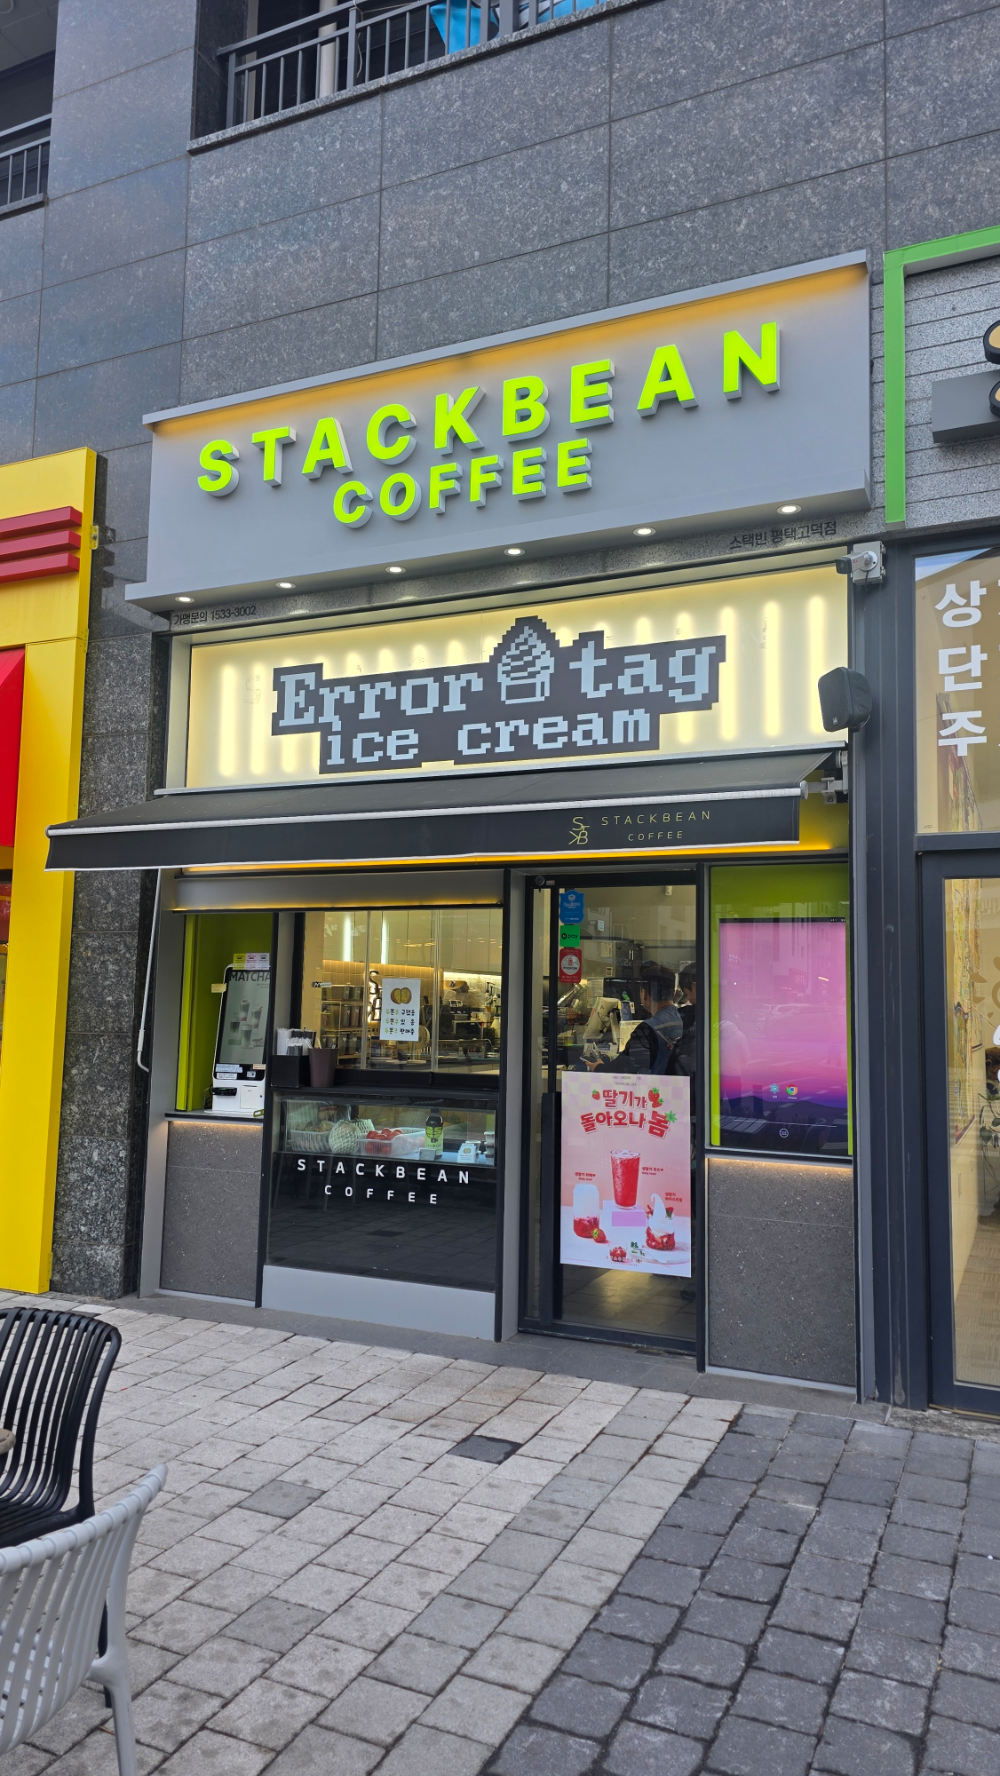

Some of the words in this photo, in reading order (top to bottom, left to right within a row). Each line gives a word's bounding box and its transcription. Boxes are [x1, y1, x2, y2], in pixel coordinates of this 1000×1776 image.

[199, 322, 780, 494] STACKBEAN
[333, 438, 590, 525] COFFEE
[729, 531, 767, 549] 스택빈
[771, 520, 837, 544] 평택고덕점
[174, 611, 208, 625] 가맹문의
[211, 605, 257, 621] 1533-3002
[279, 671, 484, 732] Error
[569, 640, 717, 703] tag
[326, 728, 419, 766] ice
[457, 708, 651, 756] cream
[601, 810, 711, 826] STACKBEAN
[627, 830, 684, 842] COFFEE
[602, 1089, 648, 1110] 딸기가
[580, 1110, 647, 1134] 돌아오나
[647, 1110, 671, 1139] 봄
[297, 1158, 470, 1185] STACKBEAN
[324, 1184, 438, 1205] COFFEE
